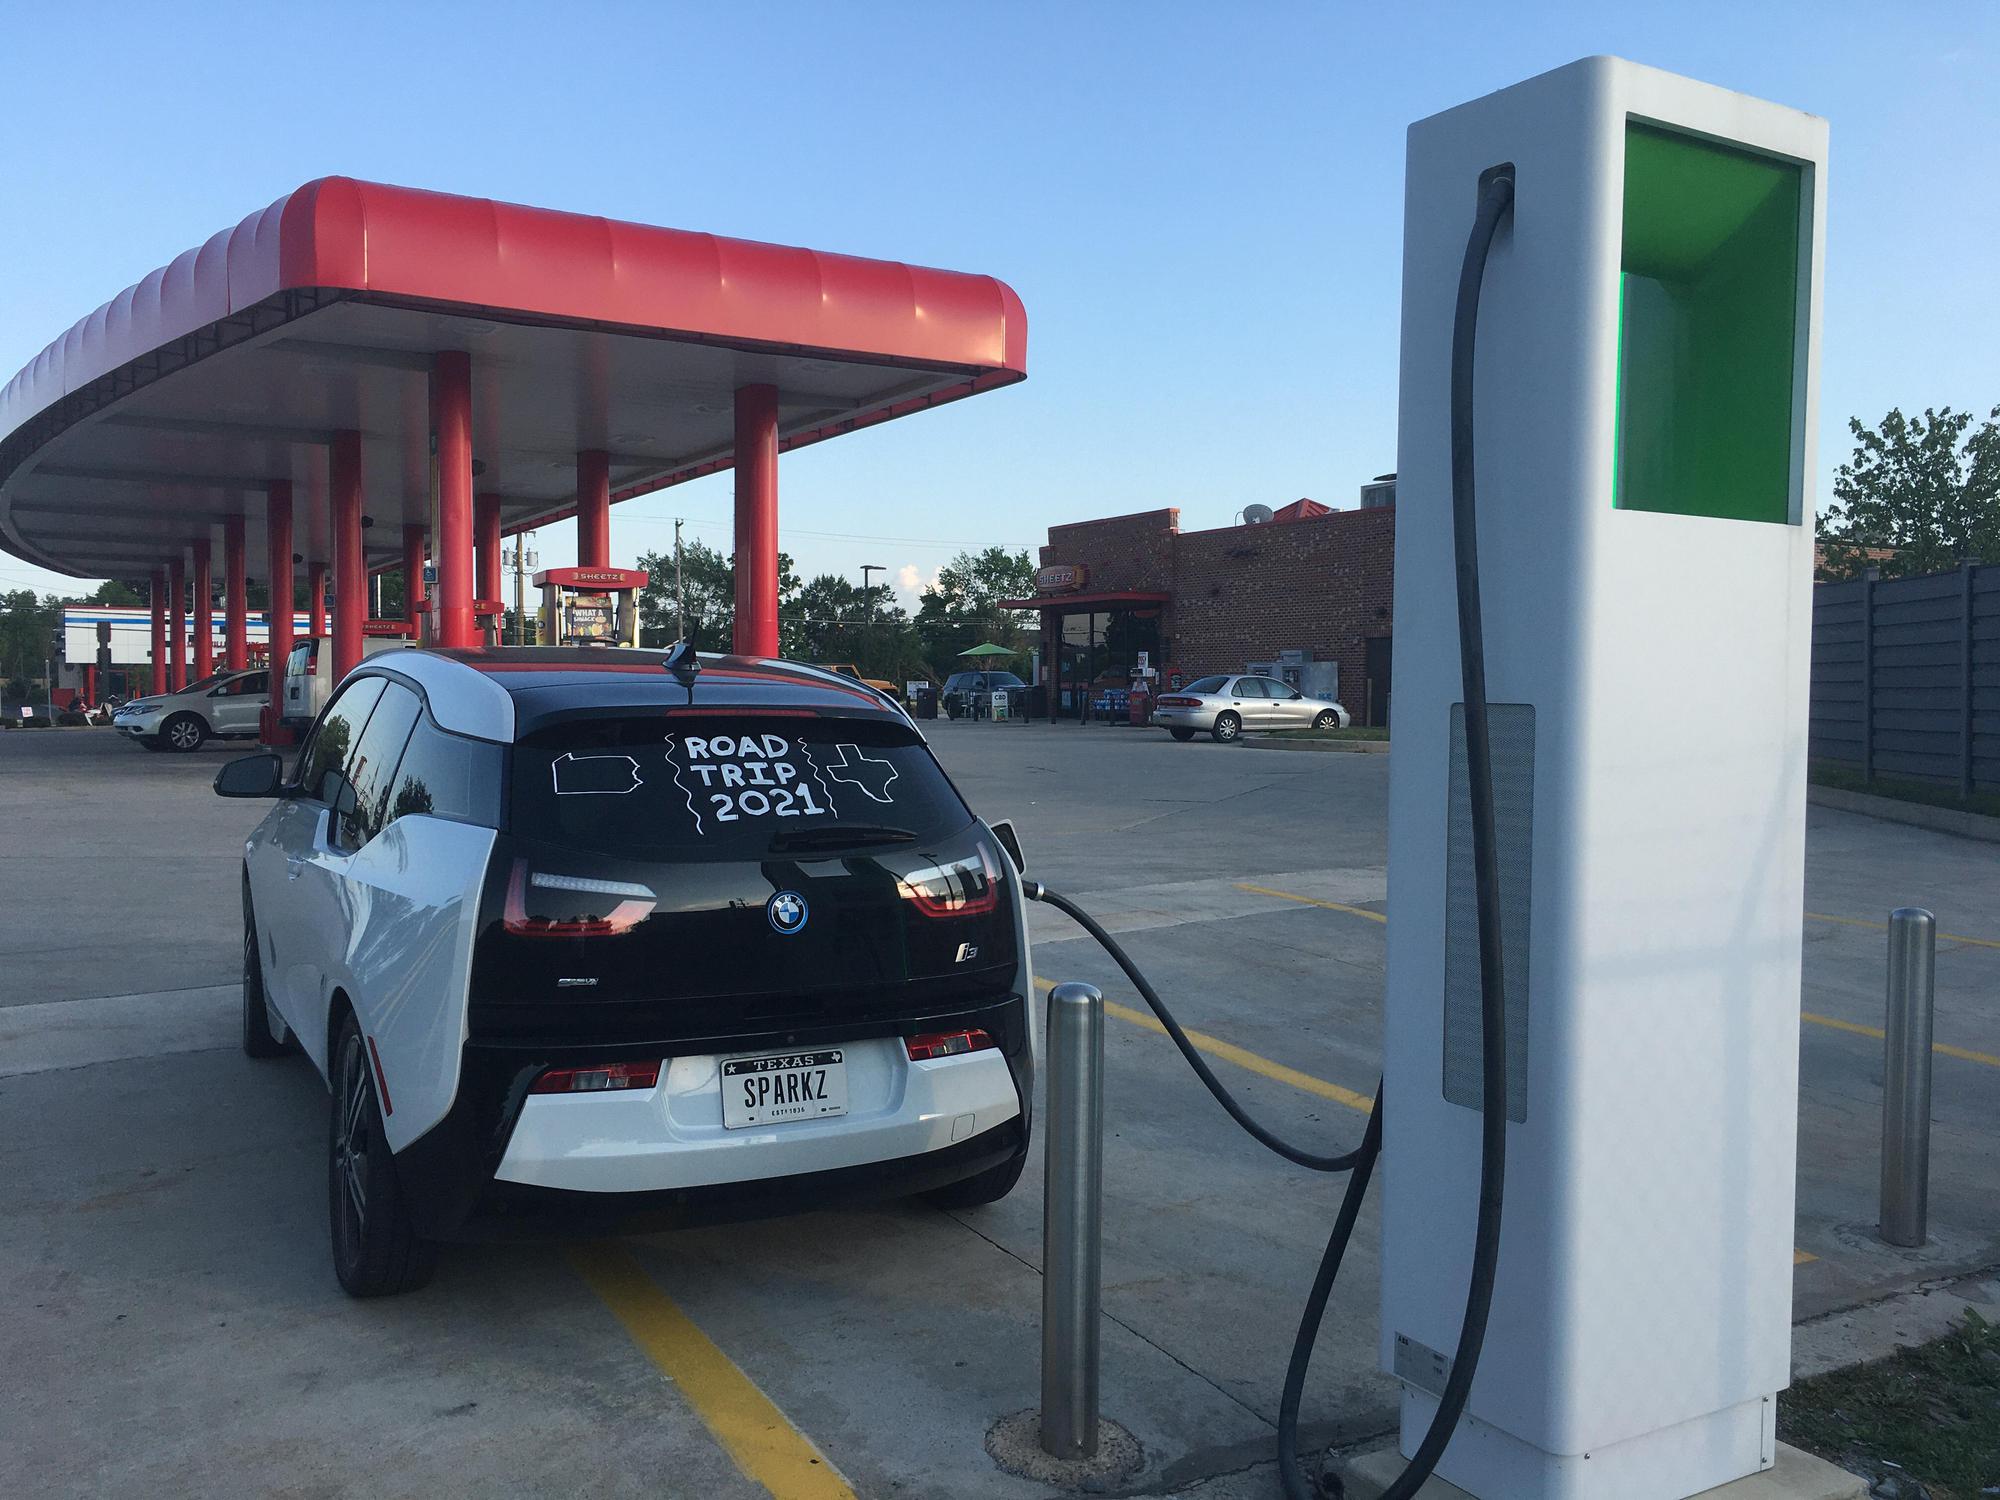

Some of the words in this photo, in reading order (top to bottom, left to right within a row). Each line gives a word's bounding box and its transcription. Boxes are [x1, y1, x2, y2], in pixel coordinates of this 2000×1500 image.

[1039, 572, 1072, 585] SHEETZ
[685, 734, 789, 759] ROAD
[690, 762, 796, 787] TRIP
[709, 783, 825, 822] 2021
[753, 1055, 815, 1071] TEXAS
[743, 1069, 828, 1108] SPARKZ
